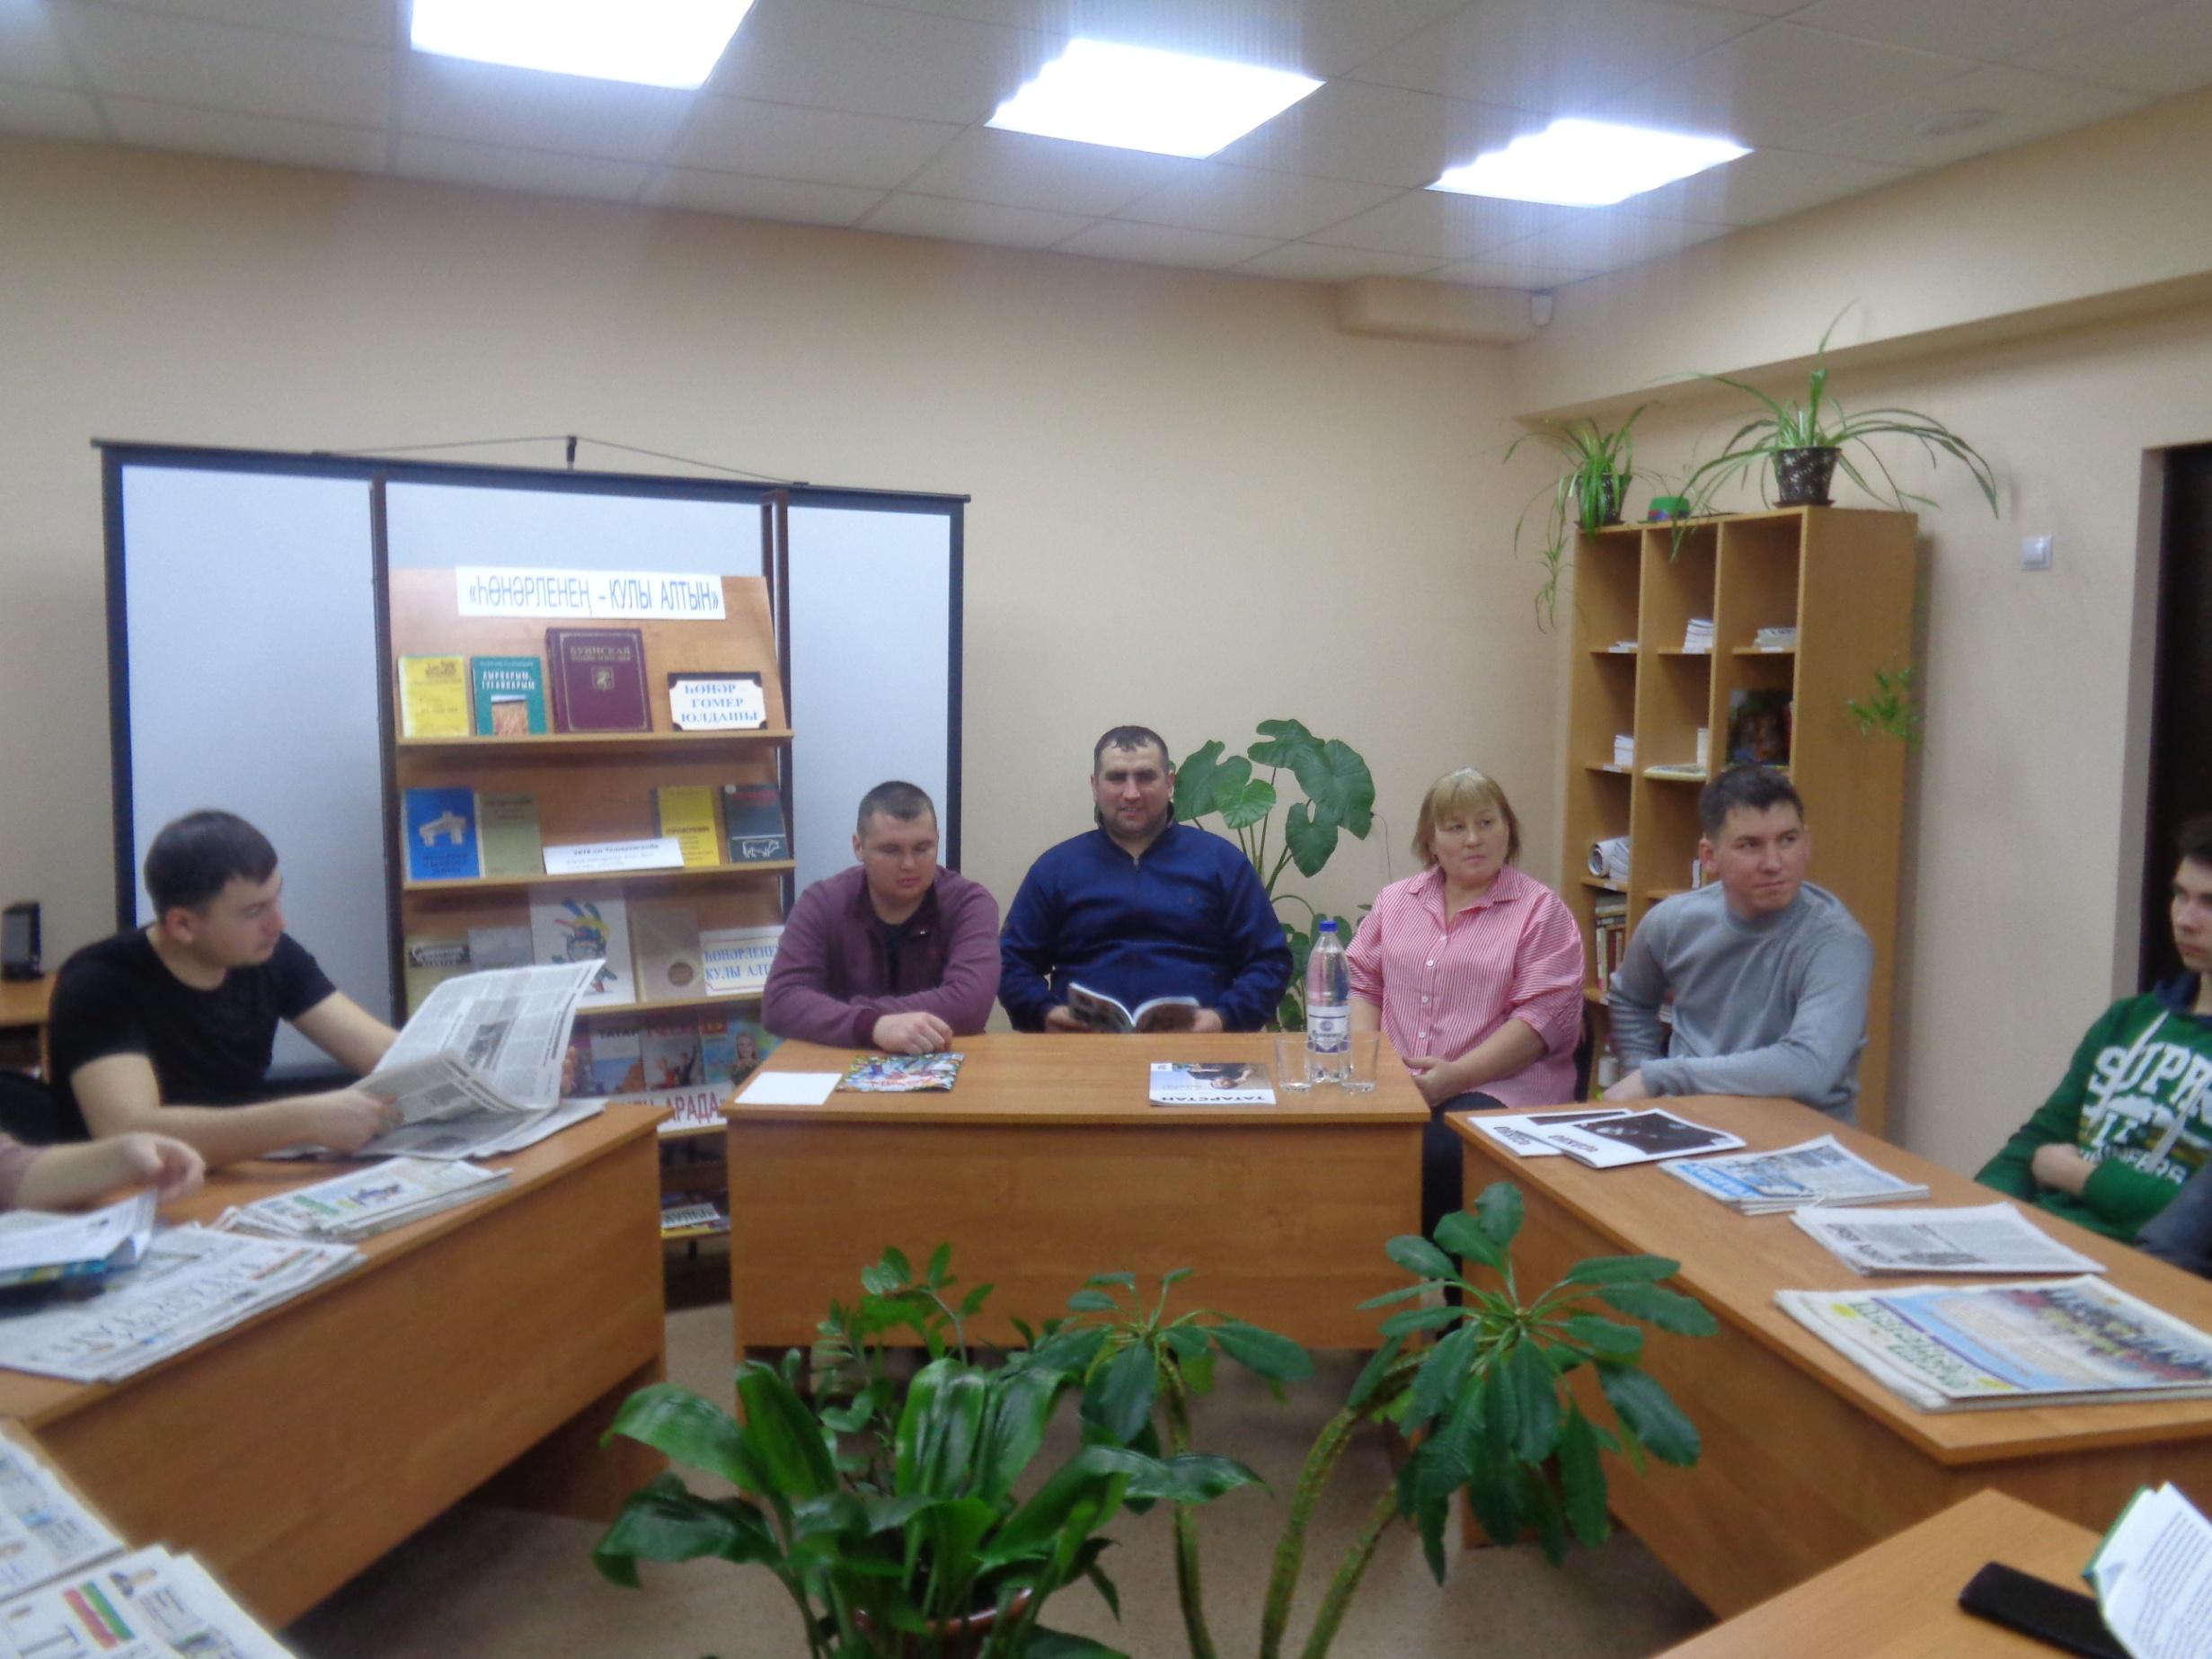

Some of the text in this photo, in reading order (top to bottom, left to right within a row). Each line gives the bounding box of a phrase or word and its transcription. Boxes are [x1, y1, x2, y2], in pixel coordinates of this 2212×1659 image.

[610, 579, 652, 608] КУЛЫ
[661, 580, 719, 611] АЛТЫН»
[692, 697, 744, 708] ГОМЕР
